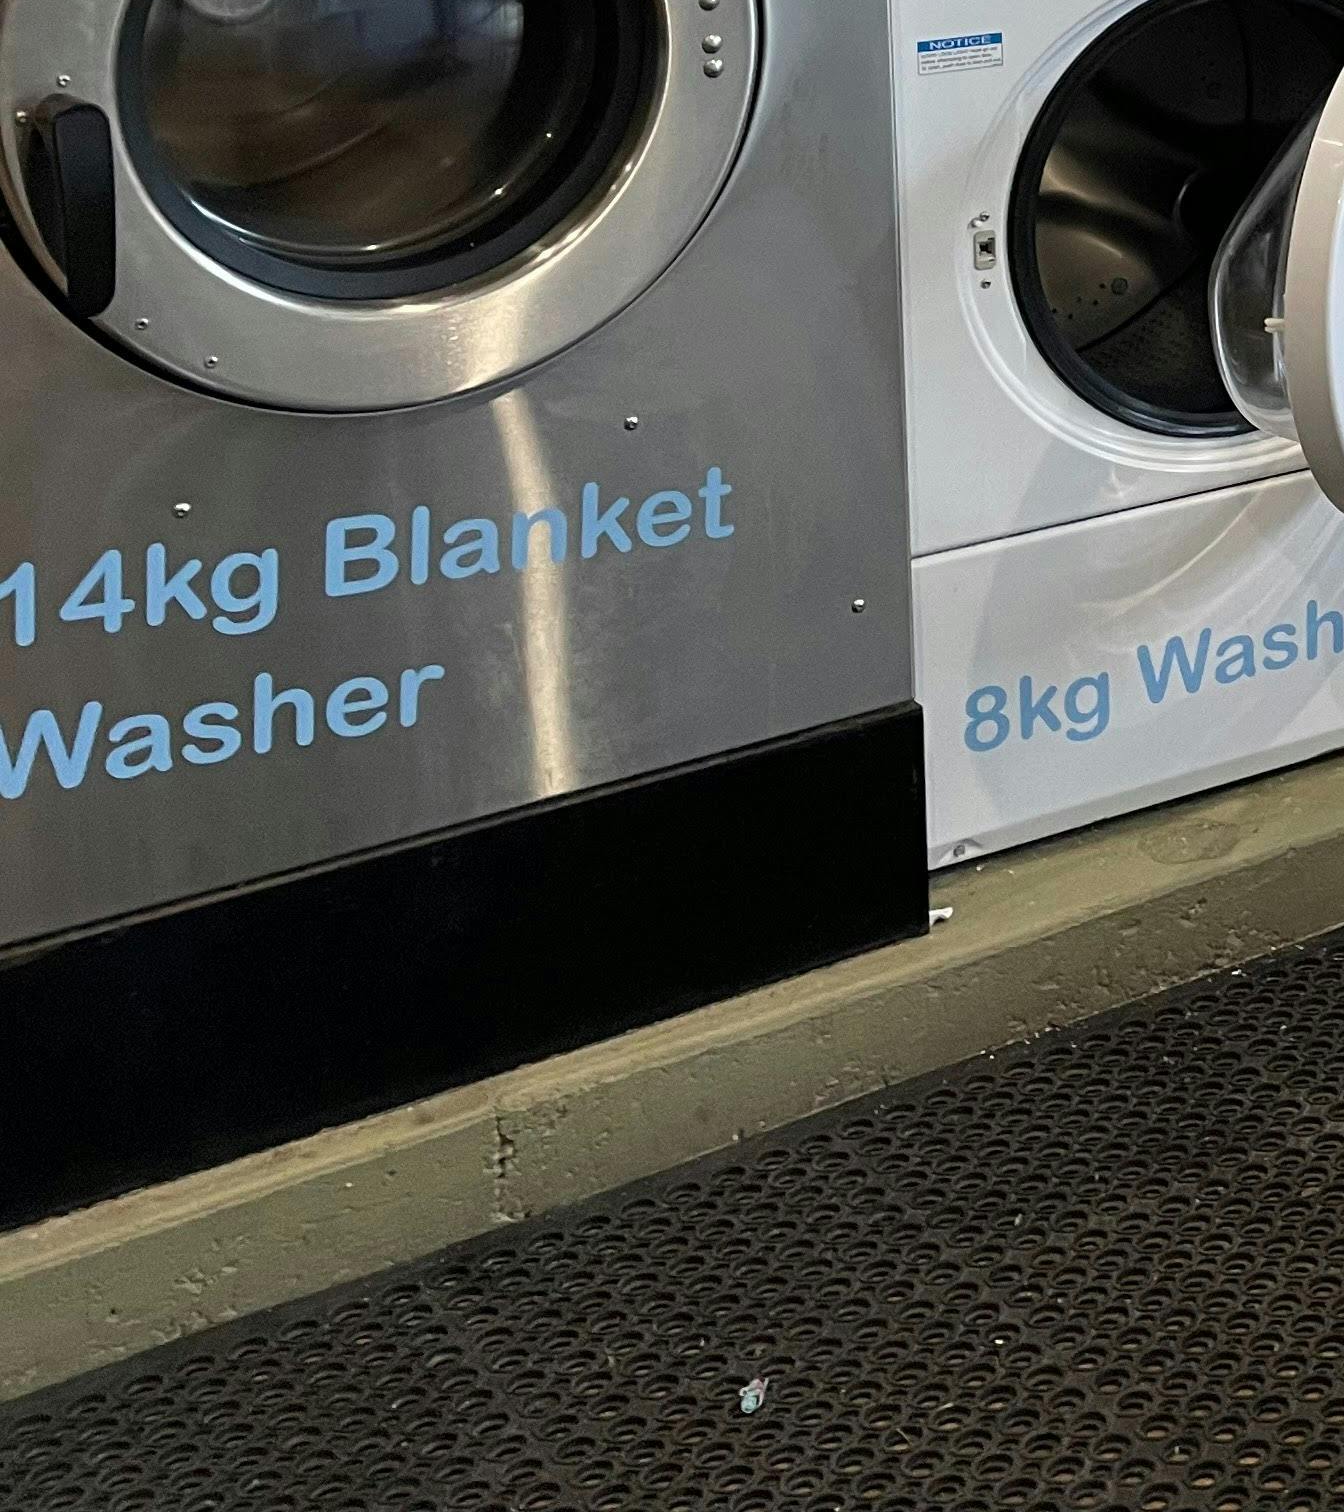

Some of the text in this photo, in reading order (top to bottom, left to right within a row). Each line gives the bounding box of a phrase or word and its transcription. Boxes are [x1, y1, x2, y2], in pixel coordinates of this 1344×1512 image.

[929, 34, 992, 50] NOTICE
[0, 466, 733, 647] 14kg Blanket
[0, 664, 446, 800] Washer
[964, 672, 1112, 753] 8kg
